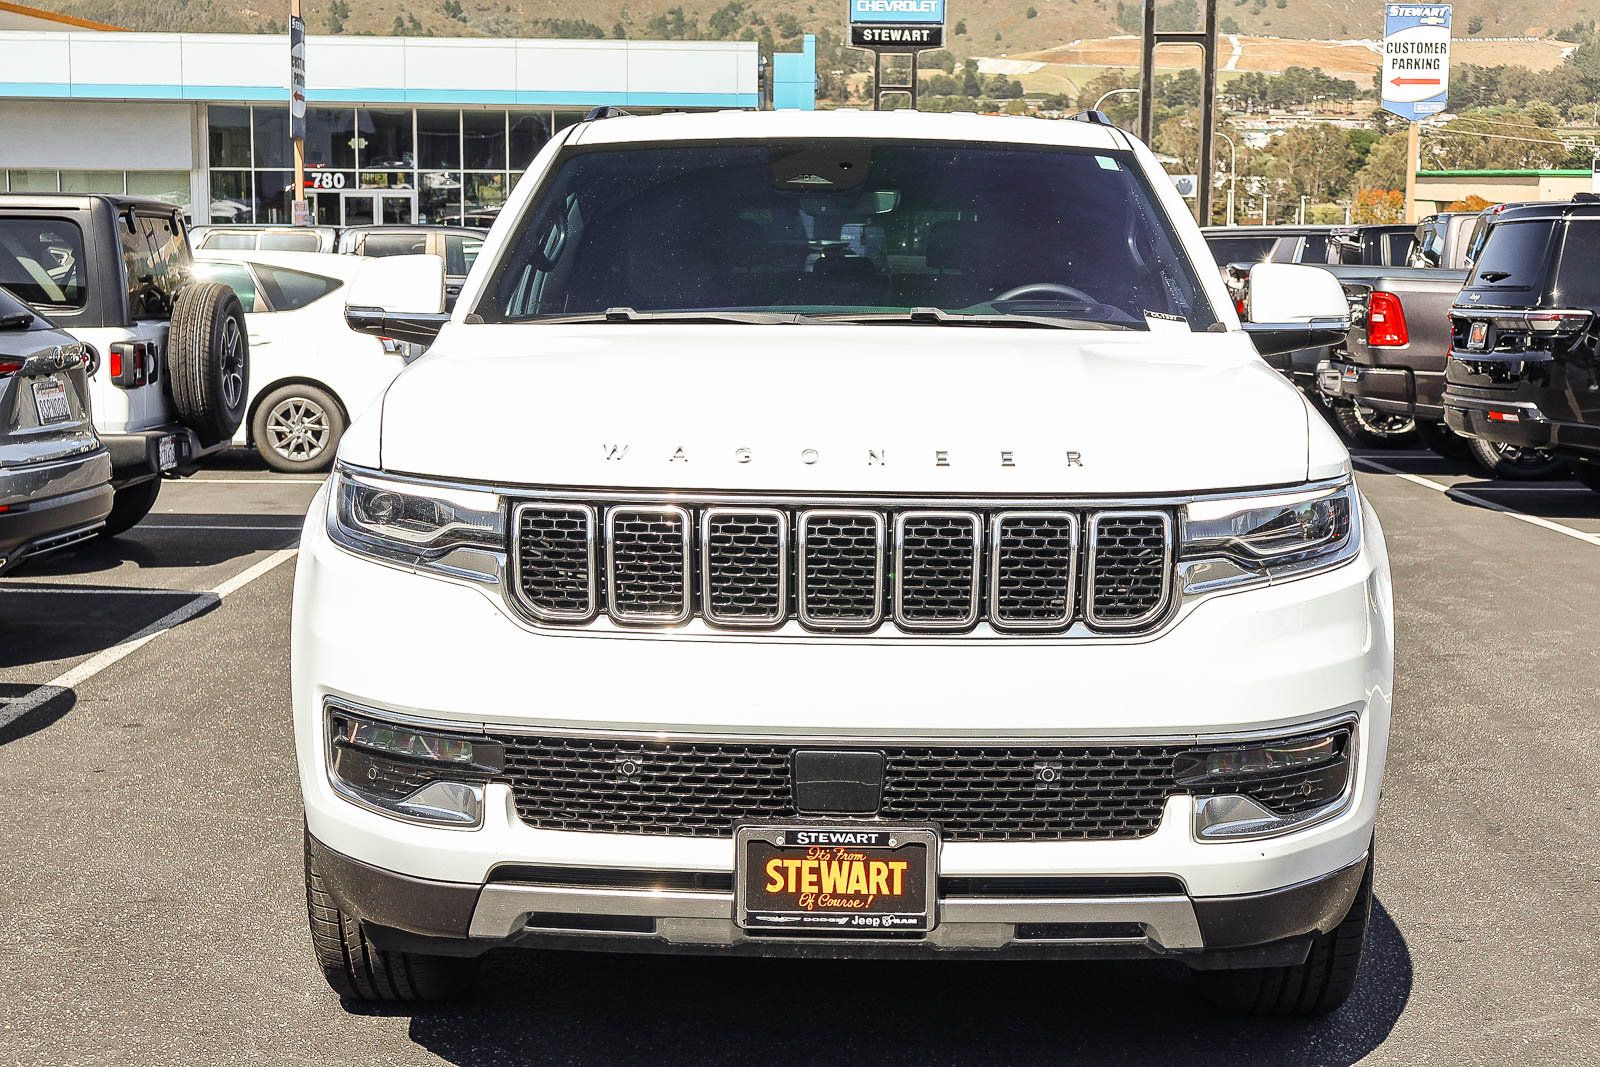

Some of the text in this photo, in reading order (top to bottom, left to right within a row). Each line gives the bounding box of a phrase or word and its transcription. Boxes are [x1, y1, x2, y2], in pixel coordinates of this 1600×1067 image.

[857, 1, 937, 12] CHEVROLET
[1389, 6, 1449, 17] STEWART
[863, 29, 930, 41] STEWART
[1386, 42, 1447, 54] CUSTOMER
[1391, 58, 1440, 70] PARKING
[311, 172, 345, 189] 780
[603, 444, 1084, 467] WAGONEER
[797, 832, 878, 844] STEWART
[832, 847, 866, 862] From
[765, 858, 907, 896] STEWART
[798, 892, 815, 911] Of
[851, 915, 880, 927] Jeep
